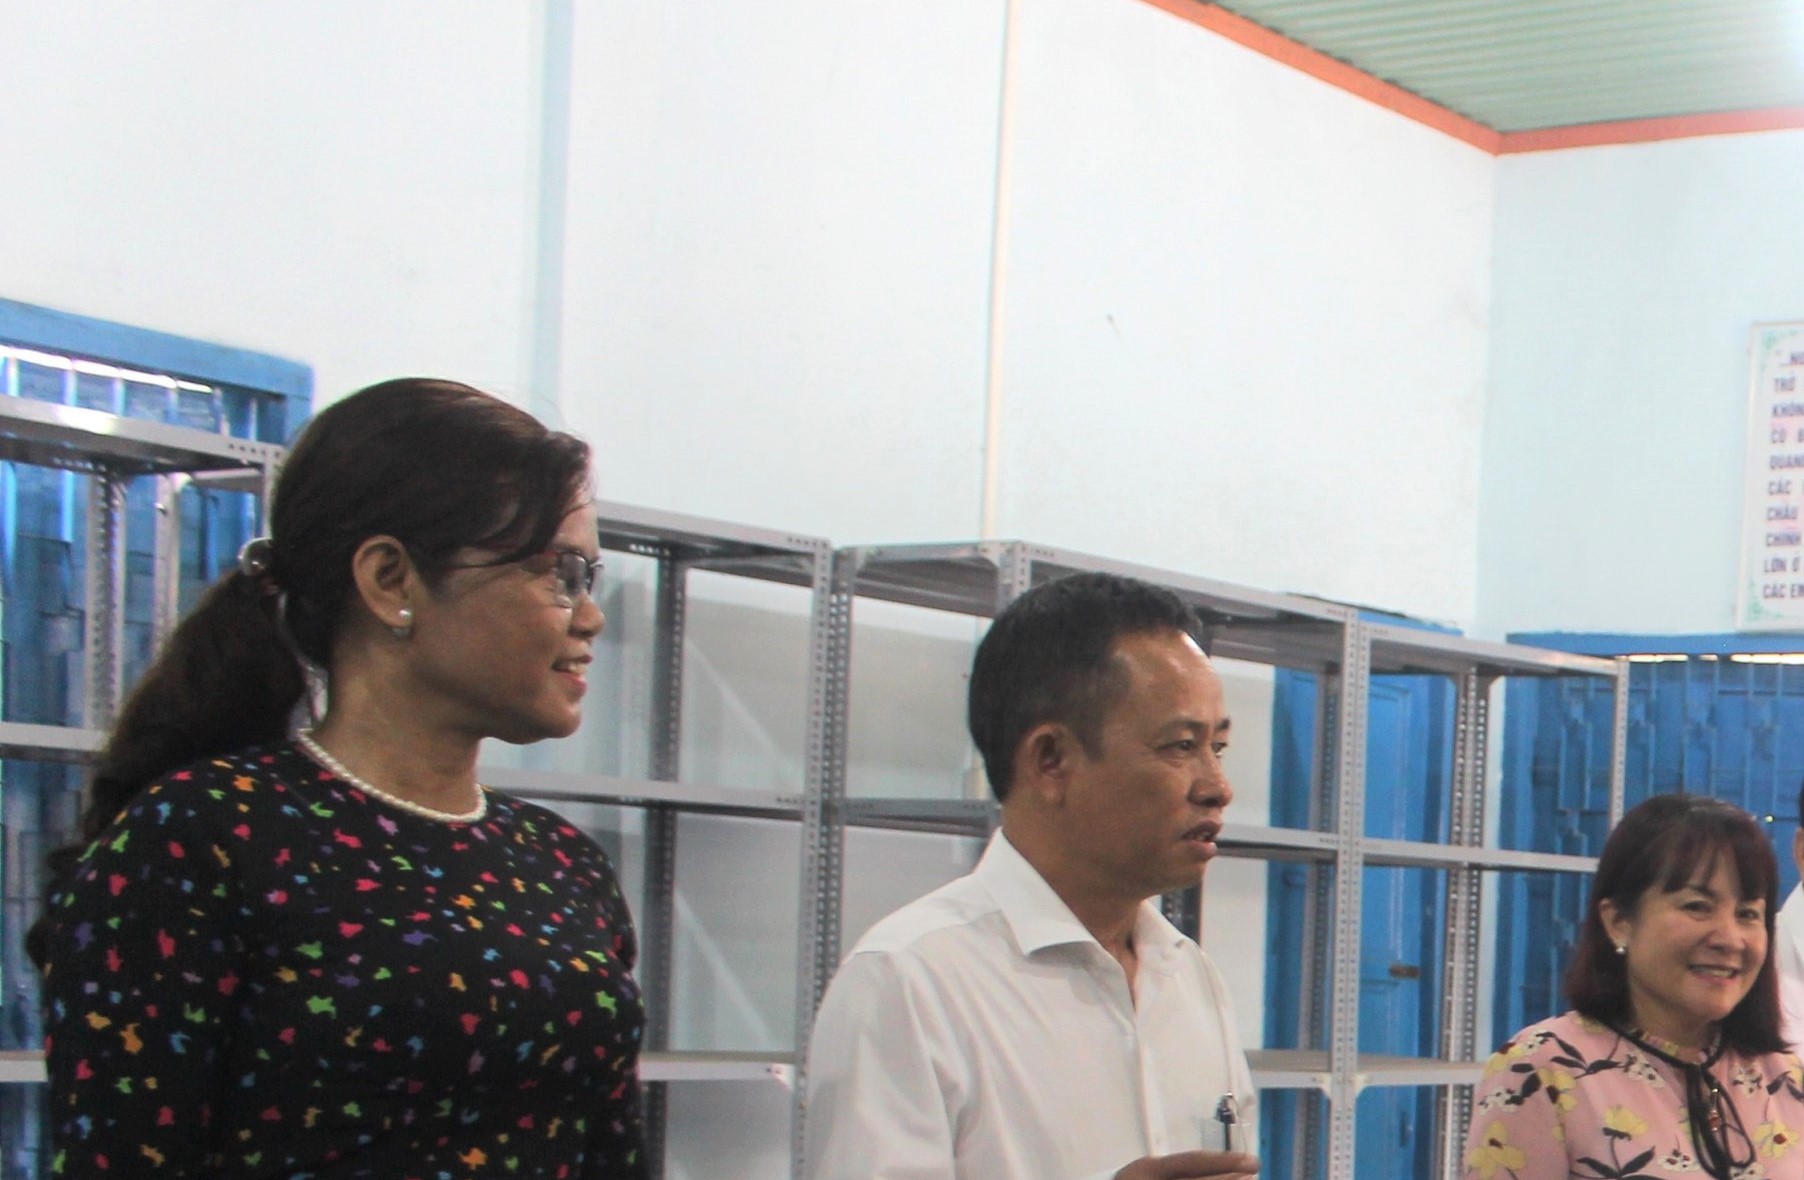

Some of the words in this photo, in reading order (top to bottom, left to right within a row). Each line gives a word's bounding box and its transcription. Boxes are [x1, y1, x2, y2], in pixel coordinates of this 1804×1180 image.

[1774, 374, 1796, 392] TRỞ
[1771, 426, 1786, 443] CÓ
[1768, 477, 1791, 495] CÁC
[1767, 504, 1798, 521] CHÂU
[1766, 531, 1801, 547] CHÍNH
[1764, 554, 1786, 573] LỚN
[1763, 583, 1786, 599] CÁC
